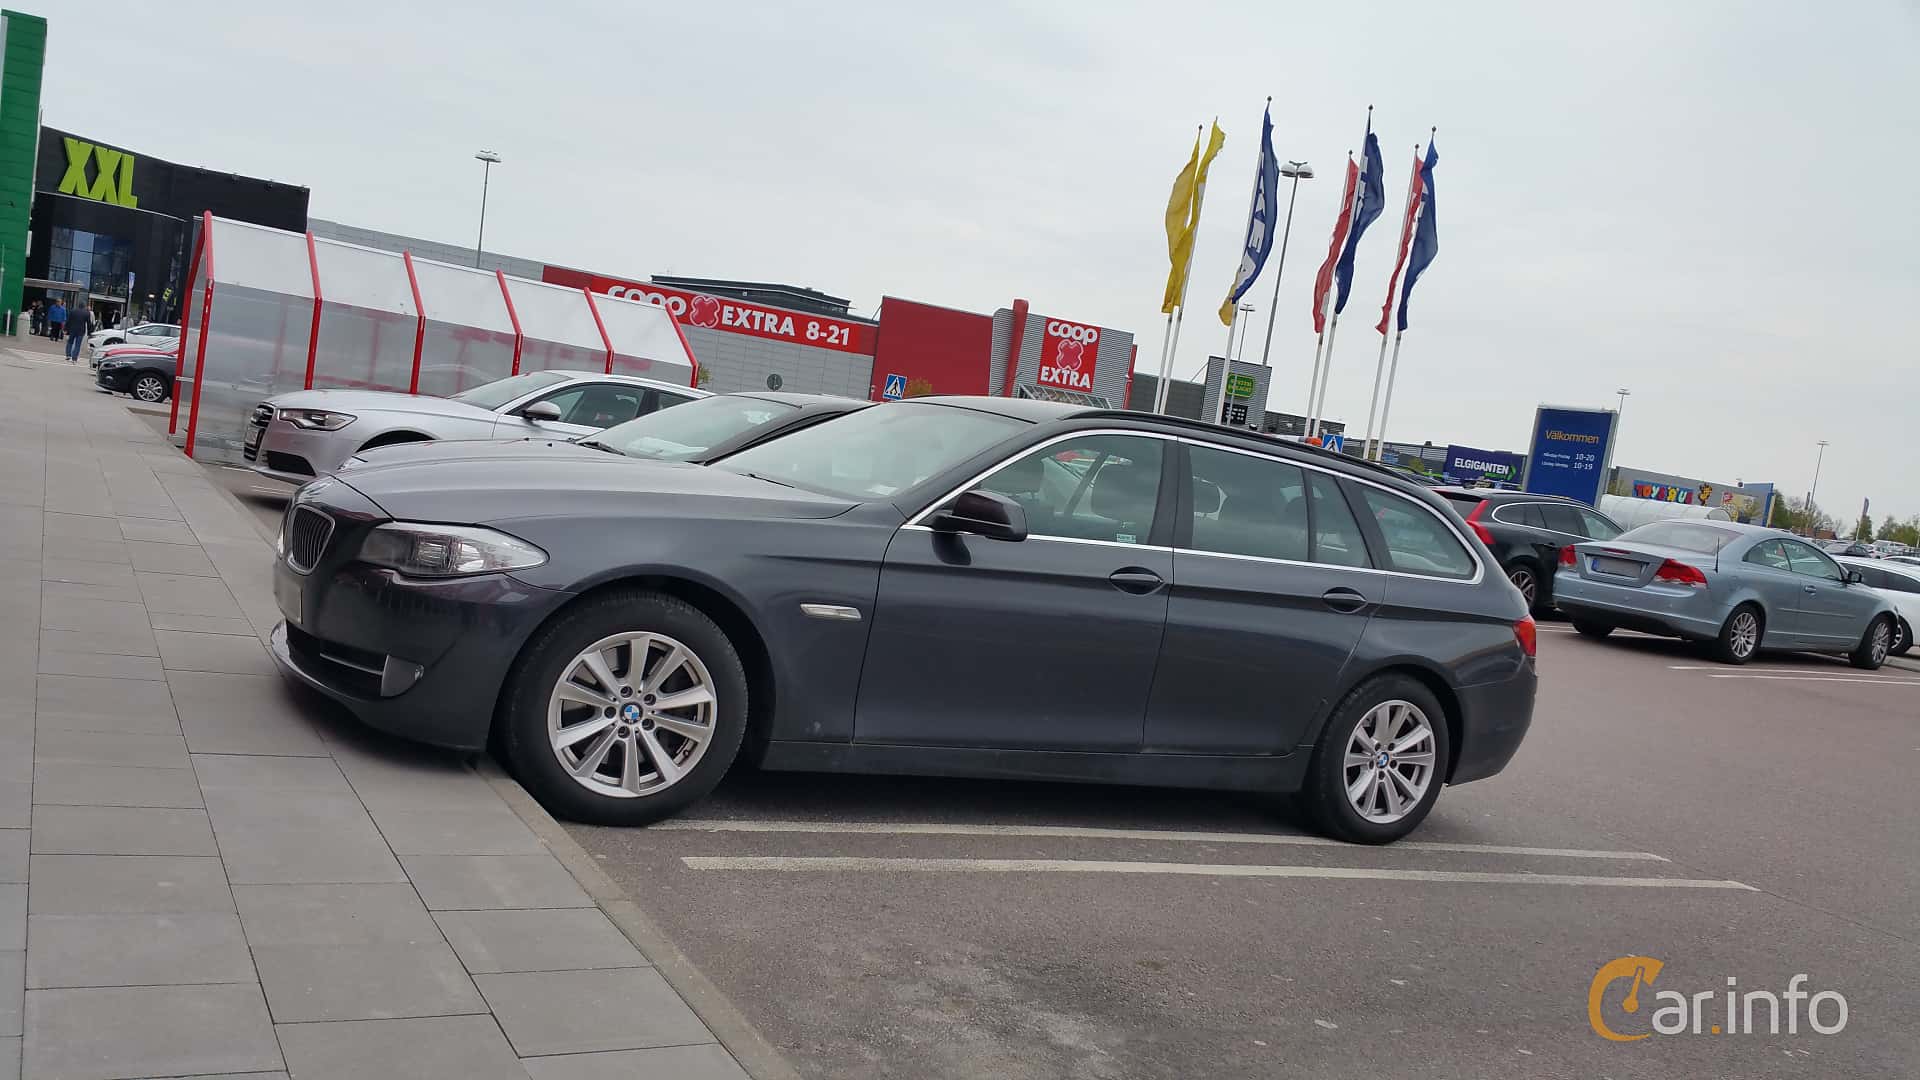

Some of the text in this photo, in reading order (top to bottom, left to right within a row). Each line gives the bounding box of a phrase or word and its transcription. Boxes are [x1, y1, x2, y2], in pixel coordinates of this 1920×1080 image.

[58, 137, 138, 209] XXL
[721, 306, 795, 337] EXTRA
[805, 321, 850, 346] 8-21
[1040, 366, 1091, 388] EXTRA
[1454, 457, 1510, 475] ELGIGANTEN
